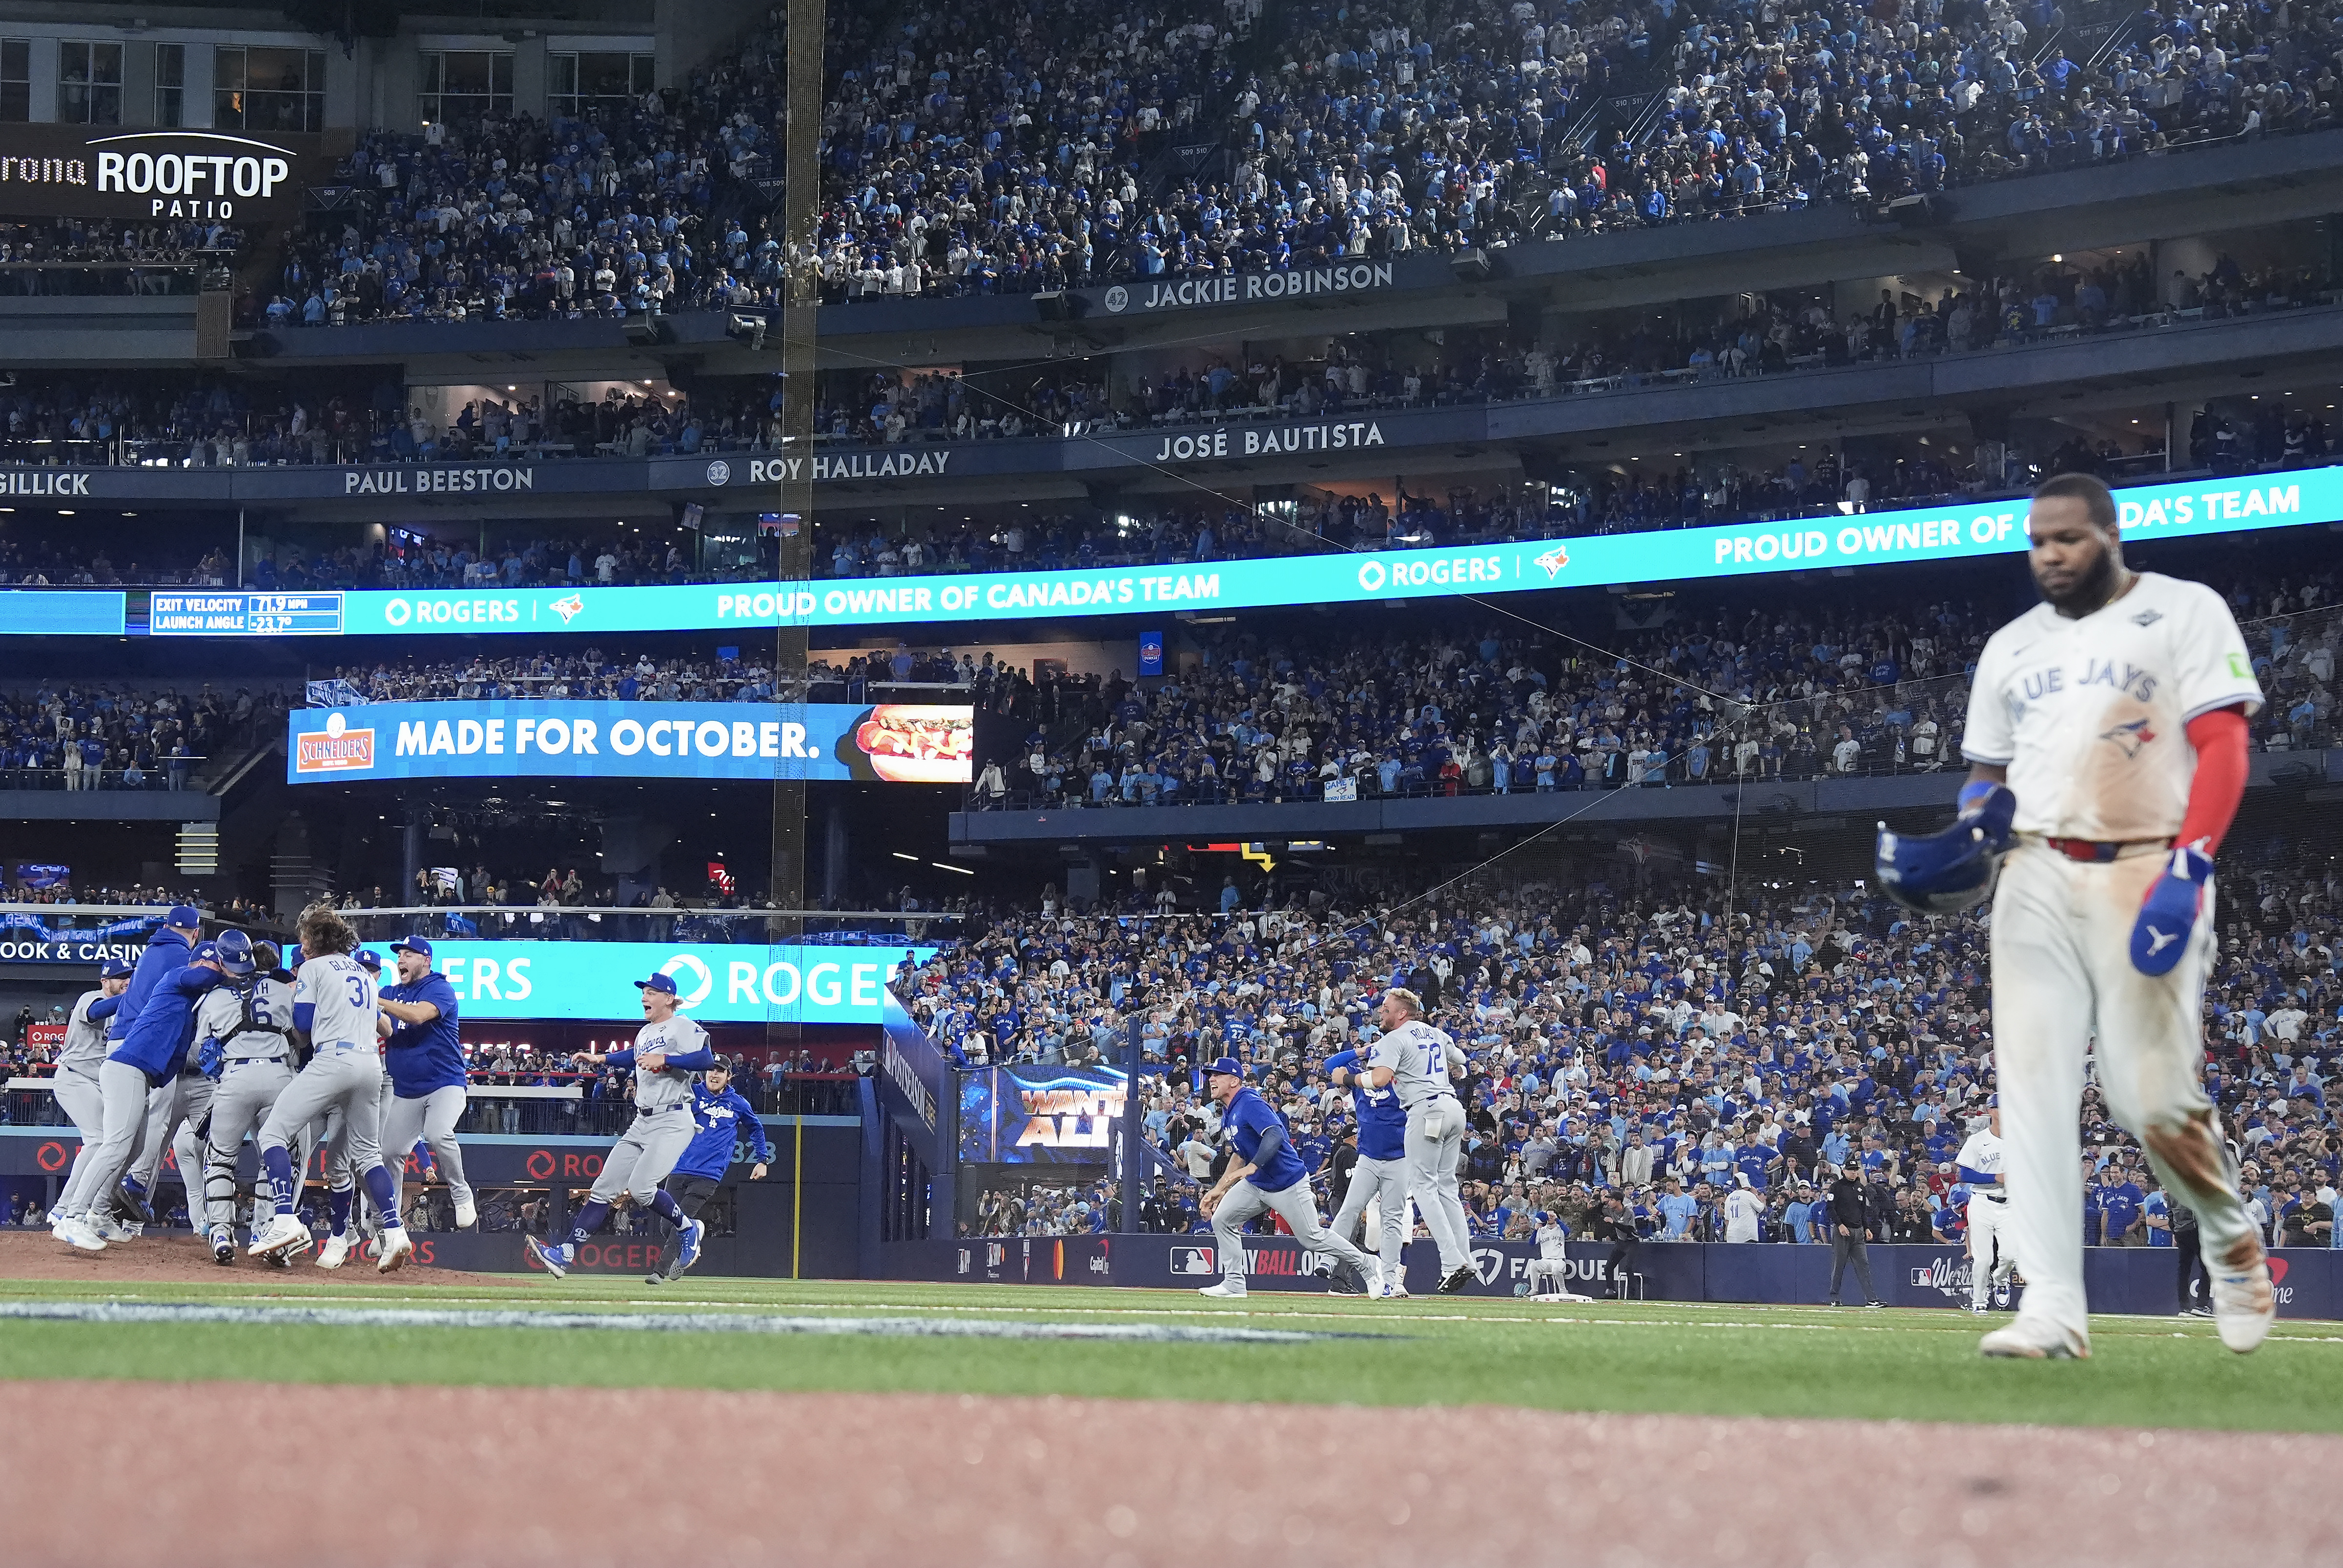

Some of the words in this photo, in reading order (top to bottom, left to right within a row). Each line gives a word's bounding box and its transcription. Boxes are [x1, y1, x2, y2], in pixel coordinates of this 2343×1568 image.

[98, 152, 288, 198] ROOFTOP
[152, 199, 233, 220] PATIO
[1108, 292, 1126, 306] 42
[1145, 277, 1237, 308] JACKIE
[1247, 262, 1393, 298] ROBINSON
[1156, 428, 1228, 461] JOSÉ
[1245, 422, 1385, 454] BAUTISTA
[710, 466, 727, 480] 32
[750, 458, 803, 482] ROY
[811, 451, 950, 479] HALLADAY
[345, 471, 408, 493] PAUL
[416, 468, 533, 492] BEESTON
[1715, 531, 1828, 564] PROUD
[1836, 519, 1961, 554] OWNER
[1970, 514, 2014, 543] OF
[2023, 495, 2194, 535] DA'S
[2201, 485, 2300, 521] TEAM
[1392, 556, 1501, 586] ROGERS
[156, 598, 183, 611] EXIT
[185, 598, 243, 611] VELOCITY
[257, 595, 286, 612] 71.9
[288, 599, 308, 610] MPH
[718, 591, 816, 618] PROUD
[824, 588, 932, 614] OWNER
[940, 586, 979, 610] OF
[987, 578, 1134, 609] CANADA'S
[1140, 574, 1219, 601] TEAM
[156, 616, 201, 629] LAUNCH
[206, 616, 244, 629] ANGLE
[417, 599, 518, 623] ROGERS
[2077, 658, 2157, 704] JAYS
[395, 719, 505, 757] MADE
[516, 718, 599, 755] FOR
[610, 719, 820, 758] OCTOBER.
[302, 737, 369, 765] SCHNEIDERS
[1325, 779, 1347, 790] GAME
[1349, 777, 1355, 786] 7
[0, 942, 49, 959] OOK
[57, 943, 71, 960] &
[79, 943, 146, 960] CASIN
[239, 951, 247, 962] LA
[363, 951, 371, 961] LA
[230, 982, 268, 1000] STH
[346, 976, 370, 1010] 31
[728, 961, 899, 1005] ROGE
[250, 998, 272, 1025] 6
[44, 1033, 64, 1041] ROG
[1232, 1029, 1244, 1039] 27
[1410, 1027, 1434, 1040] ROJAS
[636, 1036, 666, 1058] Dodgers
[1418, 1042, 1444, 1075] 72
[891, 1040, 925, 1120] POSTSEASON
[709, 1116, 717, 1128] LA
[1981, 1152, 2001, 1165] BLUE
[1730, 1204, 1739, 1218] 11
[572, 1244, 663, 1267] OGER
